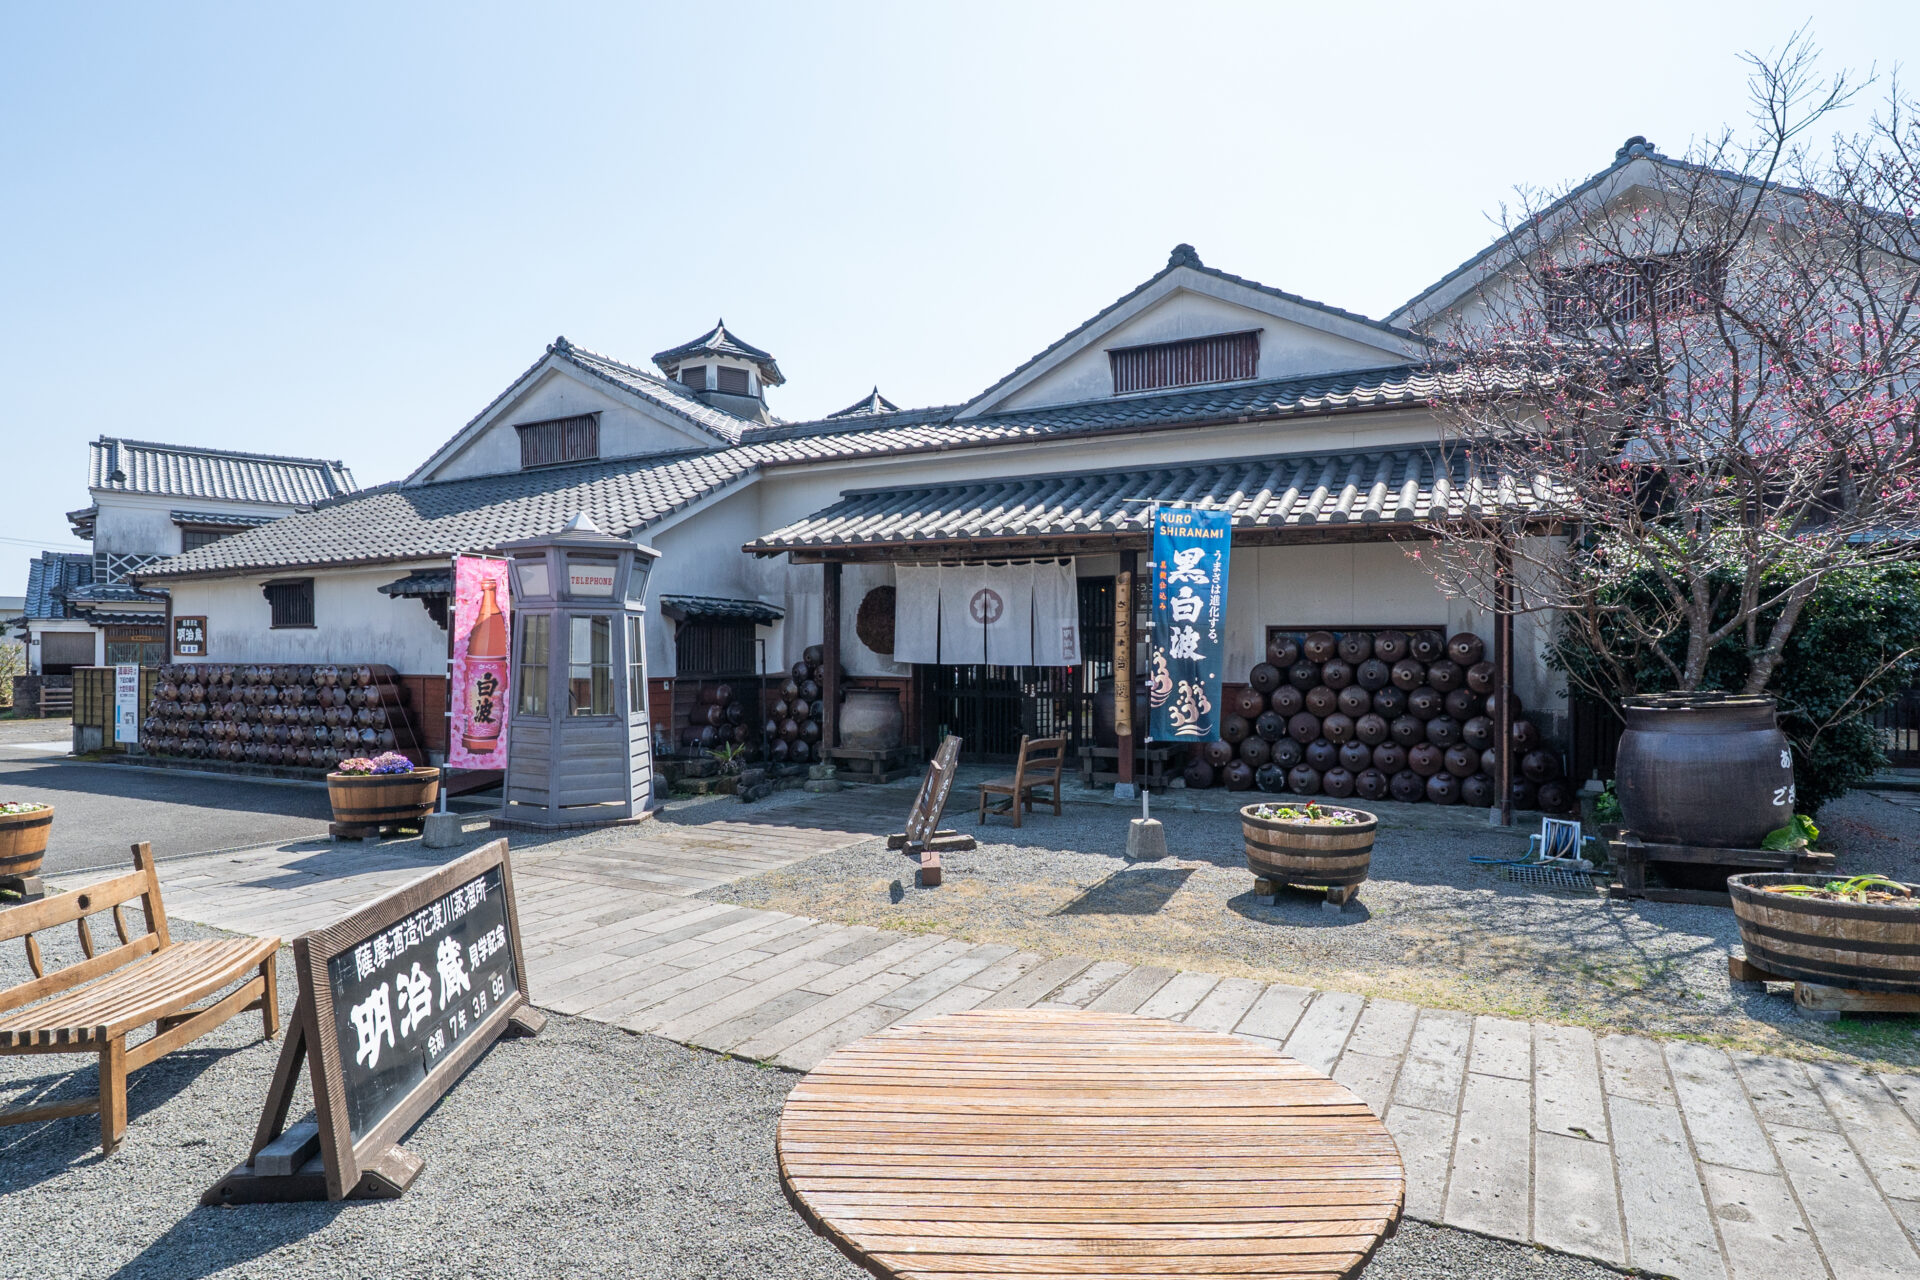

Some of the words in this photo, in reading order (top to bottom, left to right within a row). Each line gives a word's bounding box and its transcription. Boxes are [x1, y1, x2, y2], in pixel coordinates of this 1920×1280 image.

[1160, 513, 1192, 524] KURO
[1160, 526, 1224, 539] SHIRANAMI
[570, 576, 613, 586] TELEPHONE
[1168, 547, 1210, 661] 黒白波
[1208, 549, 1222, 644] うまさは進化する。
[473, 672, 499, 725] 白波
[354, 876, 487, 982] 薩摩酒造花渡川蒸溜所
[468, 923, 506, 972] 見学記念
[350, 935, 472, 1069] 明治蔵
[427, 1028, 445, 1059] 令和
[449, 1010, 467, 1039] 7年
[472, 990, 488, 1019] 3月
[492, 975, 505, 1001] 9日
